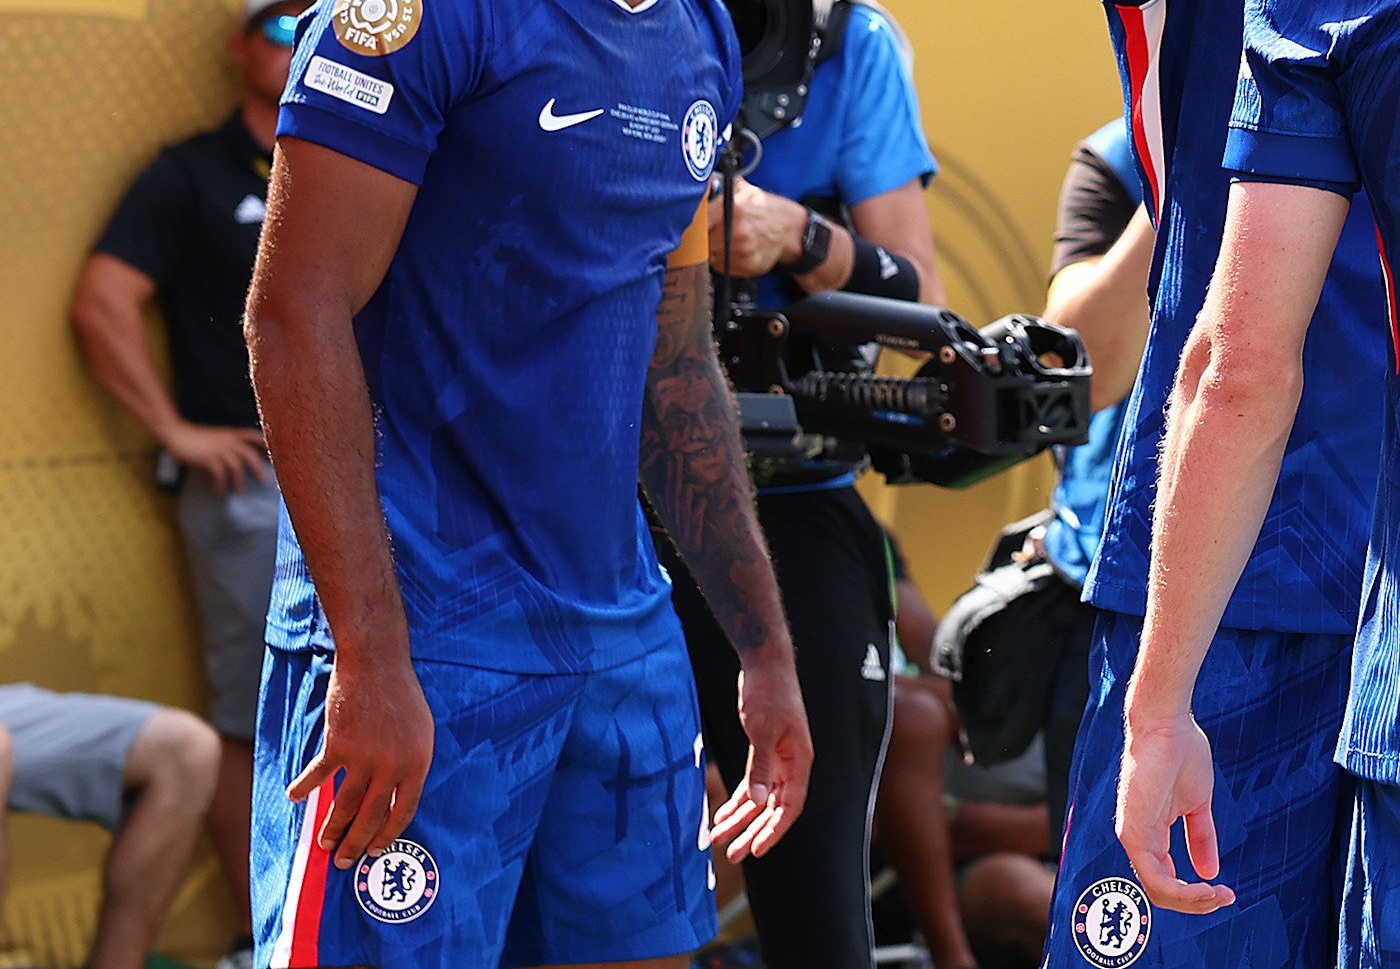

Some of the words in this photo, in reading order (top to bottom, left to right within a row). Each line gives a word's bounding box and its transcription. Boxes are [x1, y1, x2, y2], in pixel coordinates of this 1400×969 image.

[402, 7, 413, 22] 25
[344, 27, 378, 50] FIFA
[383, 23, 407, 42] USA
[319, 62, 352, 82] FOOTBALL
[355, 77, 384, 95] UNITES
[327, 77, 356, 98] World
[357, 92, 378, 106] FIFA
[1092, 881, 1142, 906] CHELSEA
[1082, 944, 1115, 966] FOOTBALL
[1116, 951, 1134, 965] CLUB
